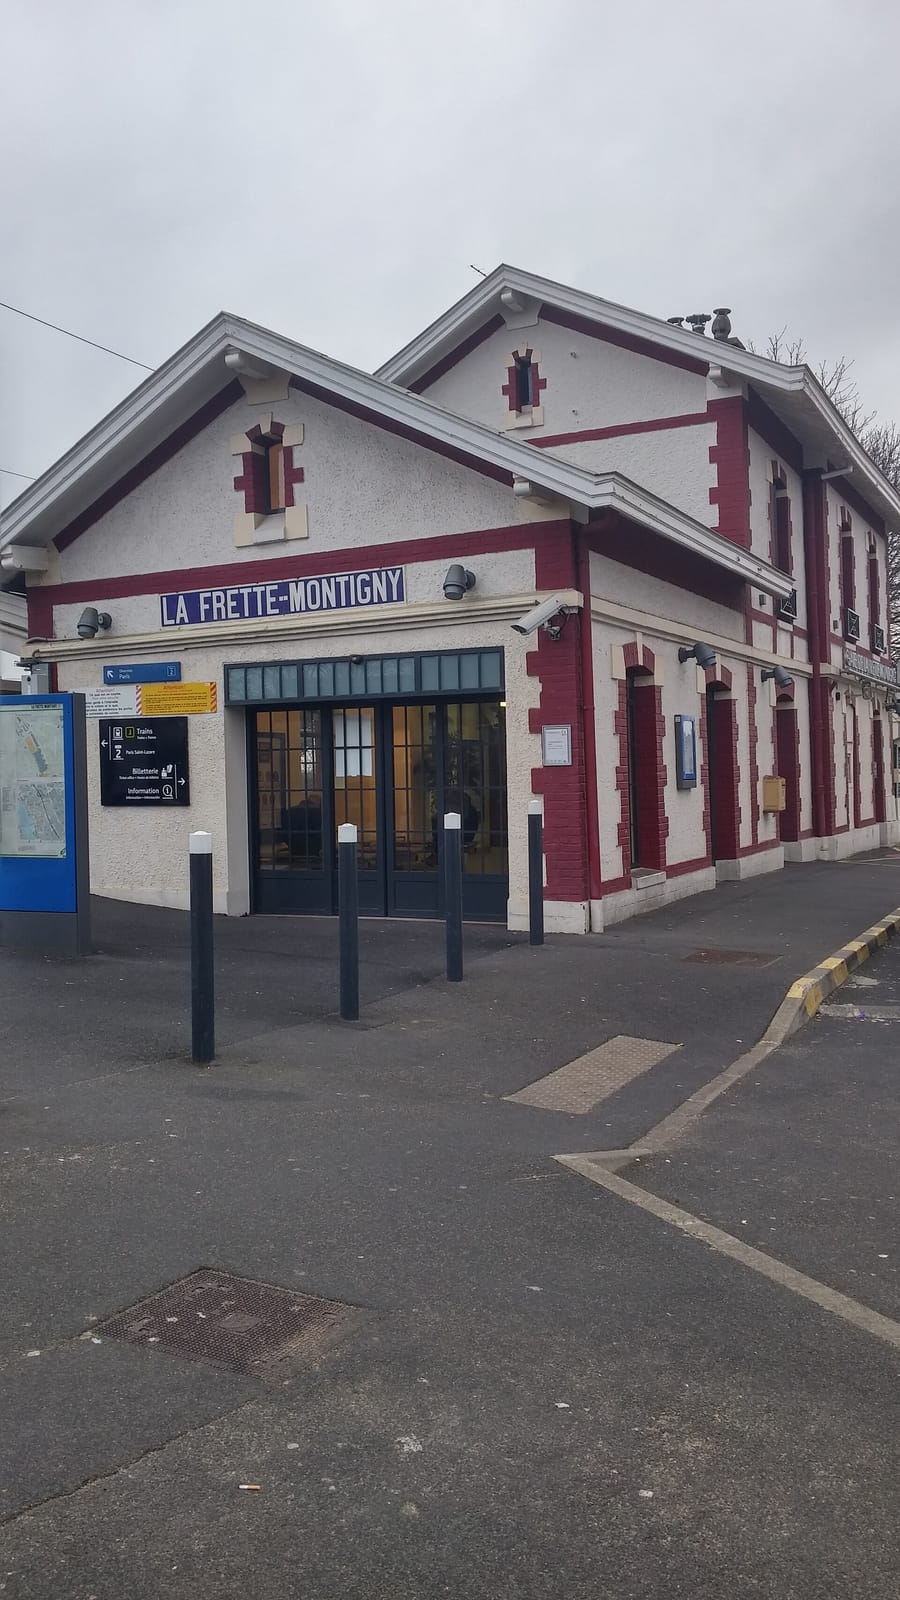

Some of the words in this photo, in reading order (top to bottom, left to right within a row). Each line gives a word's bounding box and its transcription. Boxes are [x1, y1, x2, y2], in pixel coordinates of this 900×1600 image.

[162, 594, 189, 626] LA
[199, 570, 402, 622] FRETTE-MONTIGNY
[116, 749, 121, 758] 2
